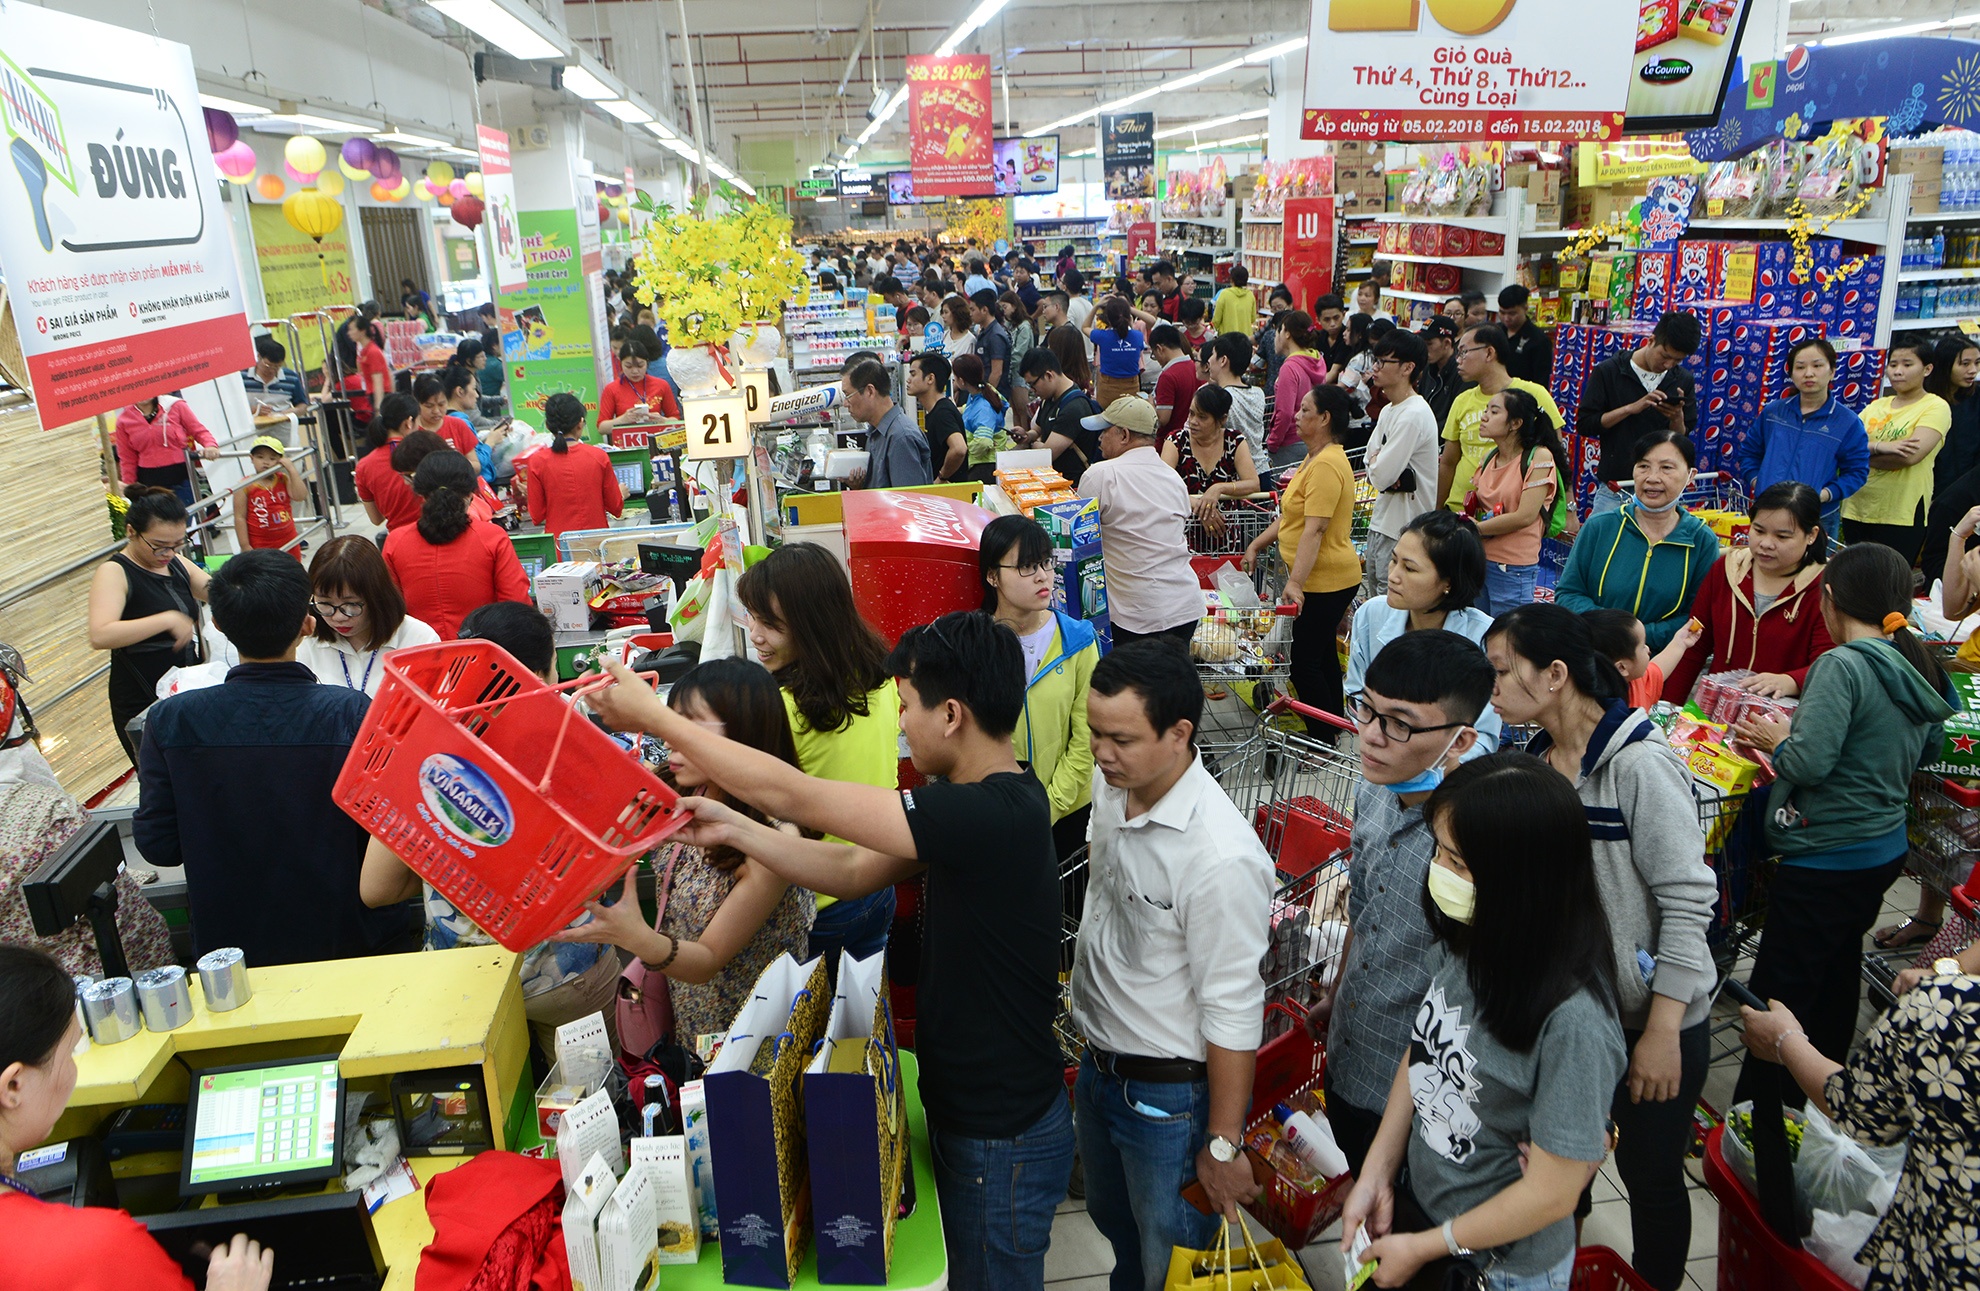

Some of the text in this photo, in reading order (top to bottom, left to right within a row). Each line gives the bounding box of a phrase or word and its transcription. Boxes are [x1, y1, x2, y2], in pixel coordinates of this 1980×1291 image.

[1433, 46, 1512, 66] Giỏ Quà
[1353, 64, 1397, 86] Thứ
[1399, 68, 1421, 90] 4,
[1430, 66, 1474, 87] Thứ
[1476, 70, 1498, 90] 8,
[1644, 65, 1691, 76] Le Gourmet
[1786, 82, 1805, 94] pepsi
[1419, 87, 1518, 109] Cùng Loại
[1314, 115, 1602, 136] Áp dụng từ 05.02.2018 đến 15.02.2018
[87, 127, 187, 200] ĐÚNG
[1609, 166, 1624, 177] DỤNG
[1625, 164, 1636, 174] TỪ
[1651, 161, 1663, 172] ĐẾN
[1663, 160, 1691, 170] 21/02/2018
[1297, 212, 1318, 239] LU
[532, 247, 573, 265] THOẠI
[27, 277, 55, 293] Khách
[57, 275, 79, 291] hàng
[91, 272, 109, 287] được
[110, 271, 129, 285] nhận
[142, 264, 162, 283] phẩm
[161, 261, 179, 278] MIỄN
[180, 262, 193, 275] PHÍ
[193, 262, 204, 273] nếu
[526, 269, 569, 281] re-paid Card
[62, 295, 73, 303] FREE
[138, 302, 161, 314] KHÔNG
[162, 296, 179, 312] NHẬN
[180, 295, 194, 309] DIỆN
[203, 290, 215, 304] SẢN
[215, 286, 230, 301] PHẨM
[49, 304, 118, 330] SAI GIÁ SẢN PHẨM
[53, 332, 70, 341] WRONG
[51, 368, 67, 382] Applied
[74, 366, 91, 378] product
[745, 385, 758, 412] 0
[770, 393, 821, 413] Energizer
[702, 413, 733, 445] 21
[272, 511, 290, 524] USA
[1052, 504, 1082, 513] Gillette
[1079, 565, 1102, 577] VECTOR
[1919, 761, 1980, 777] einek
[432, 764, 501, 835] VINAMILK
[562, 1022, 591, 1037] Bánh gạo
[581, 1028, 602, 1040] TÍCH
[1413, 1000, 1466, 1091] OMG
[570, 1101, 599, 1121] Bánh gạo
[590, 1105, 610, 1120] TÍCH
[635, 1143, 669, 1153] Bánh gạo
